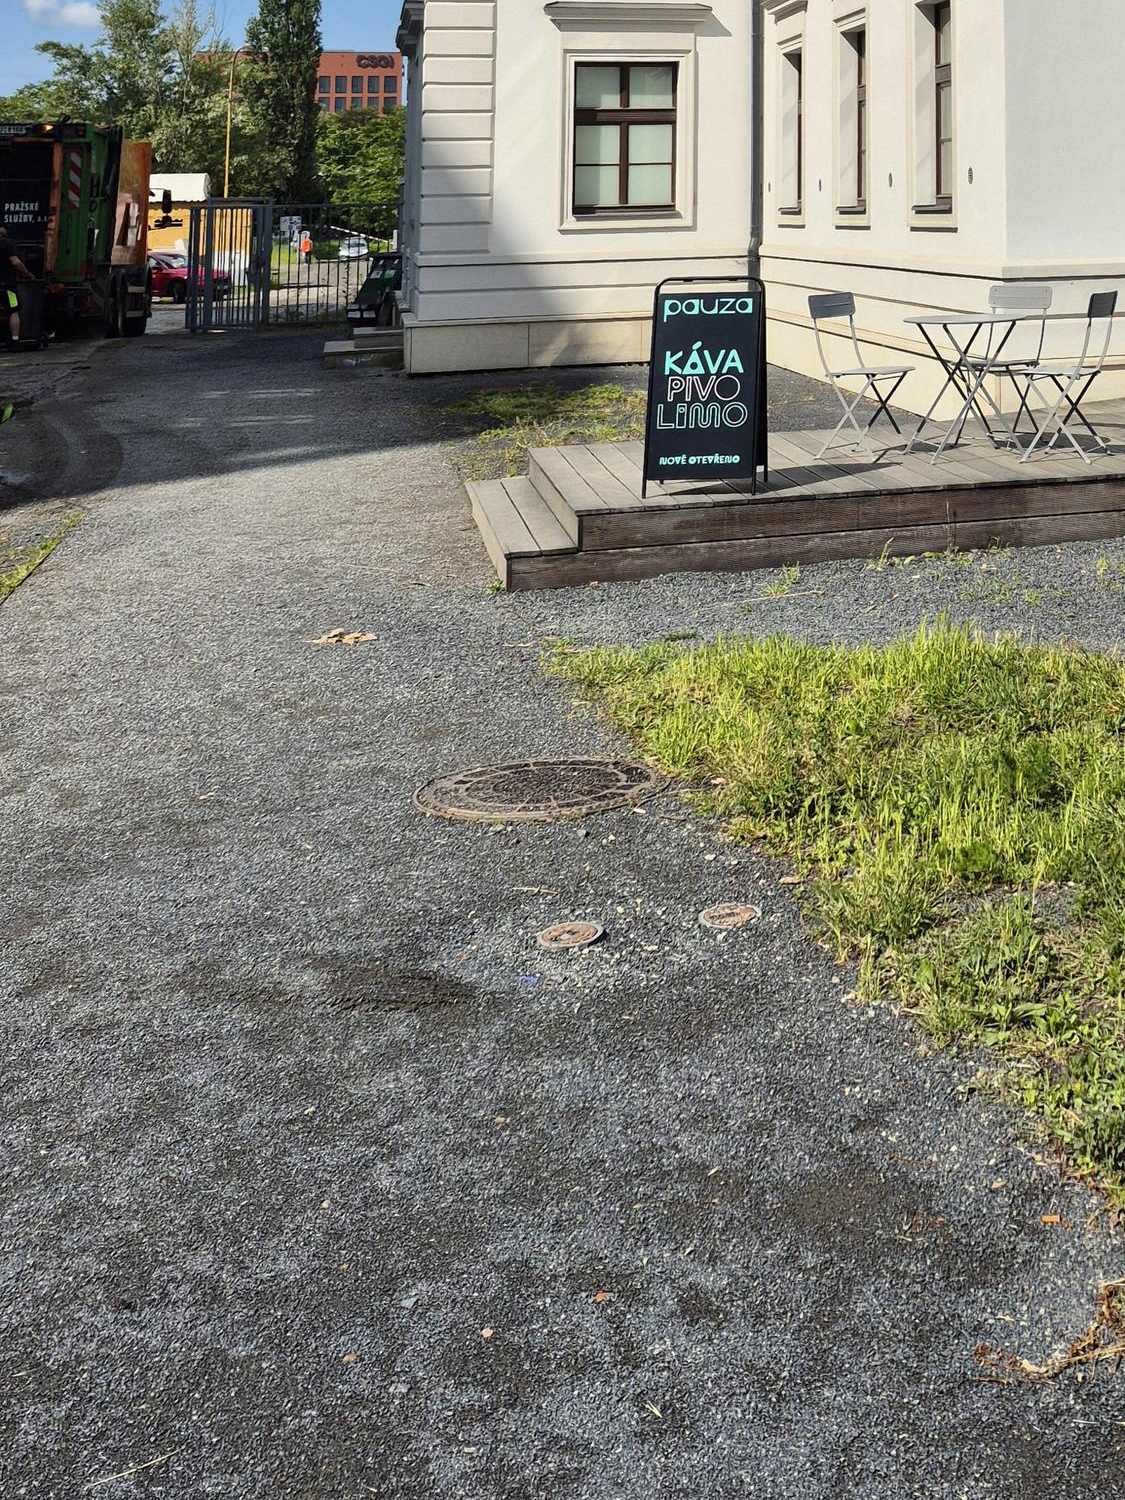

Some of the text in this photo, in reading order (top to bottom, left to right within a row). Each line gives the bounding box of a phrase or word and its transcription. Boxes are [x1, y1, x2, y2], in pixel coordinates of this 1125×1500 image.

[4, 201, 39, 211] PRAŽSKÉ
[663, 298, 753, 323] pauza
[664, 341, 744, 375] KÁVA
[667, 375, 741, 402] PIVO
[688, 453, 740, 465] OTEVŘENO
